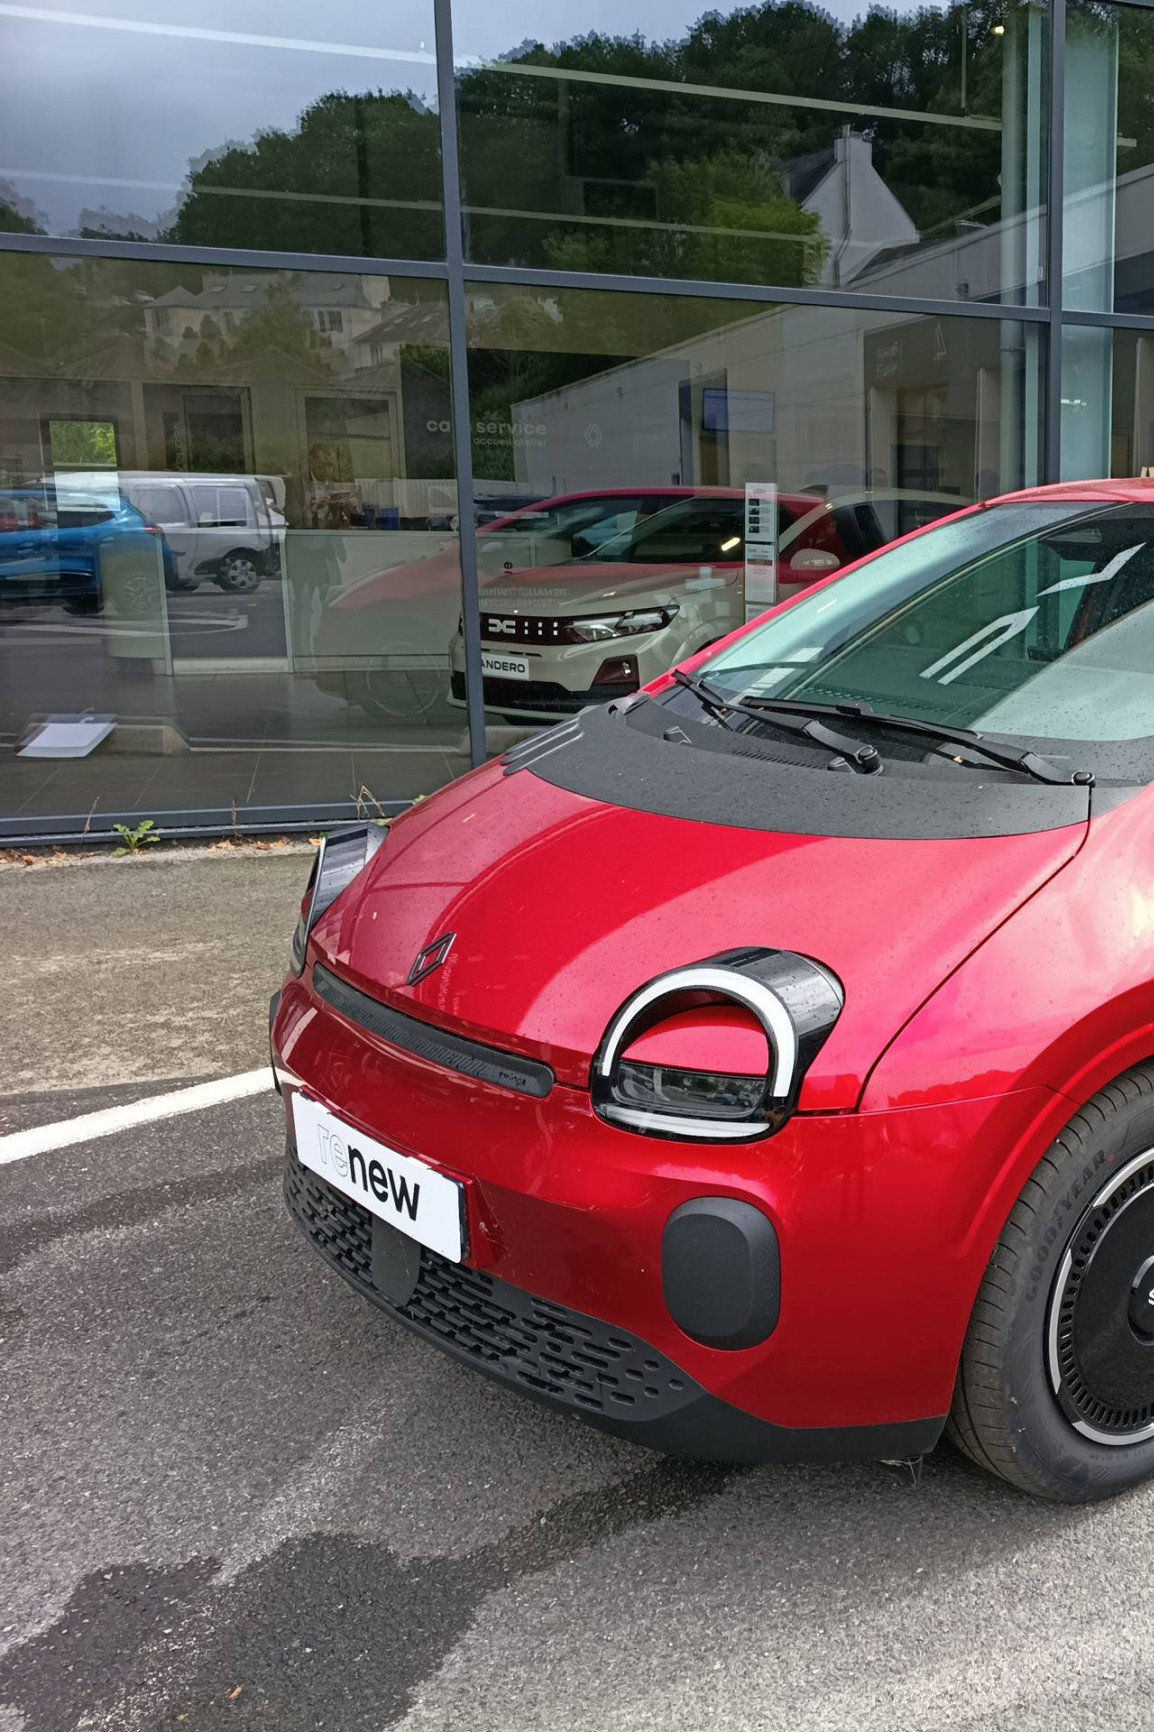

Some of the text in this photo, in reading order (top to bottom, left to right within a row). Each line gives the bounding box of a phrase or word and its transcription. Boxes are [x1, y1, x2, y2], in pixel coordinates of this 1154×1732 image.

[475, 420, 547, 436] service
[473, 437, 512, 446] accueil
[481, 660, 526, 674] ANDERO
[317, 1123, 420, 1222] renew
[1025, 1149, 1106, 1303] GOODYEAR
